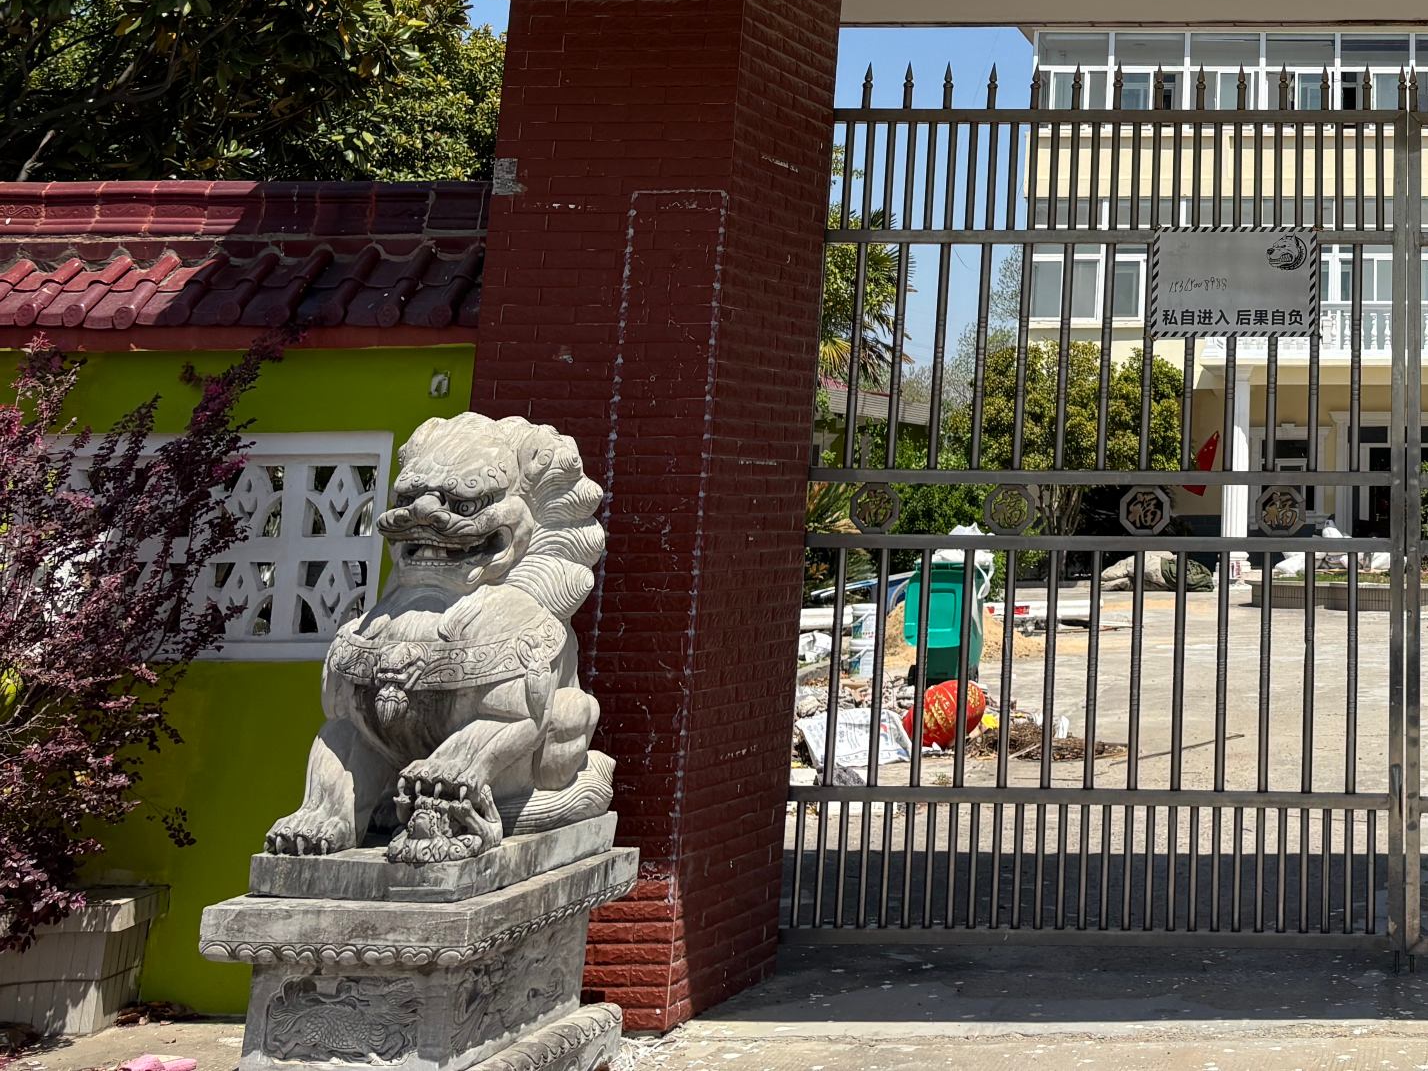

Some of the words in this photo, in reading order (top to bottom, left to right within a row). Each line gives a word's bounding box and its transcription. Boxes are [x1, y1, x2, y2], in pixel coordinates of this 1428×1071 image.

[1162, 309, 1230, 326] 私自进入
[1236, 309, 1304, 326] 后果自负
[1128, 491, 1163, 527] 福
[1263, 491, 1298, 527] 福
